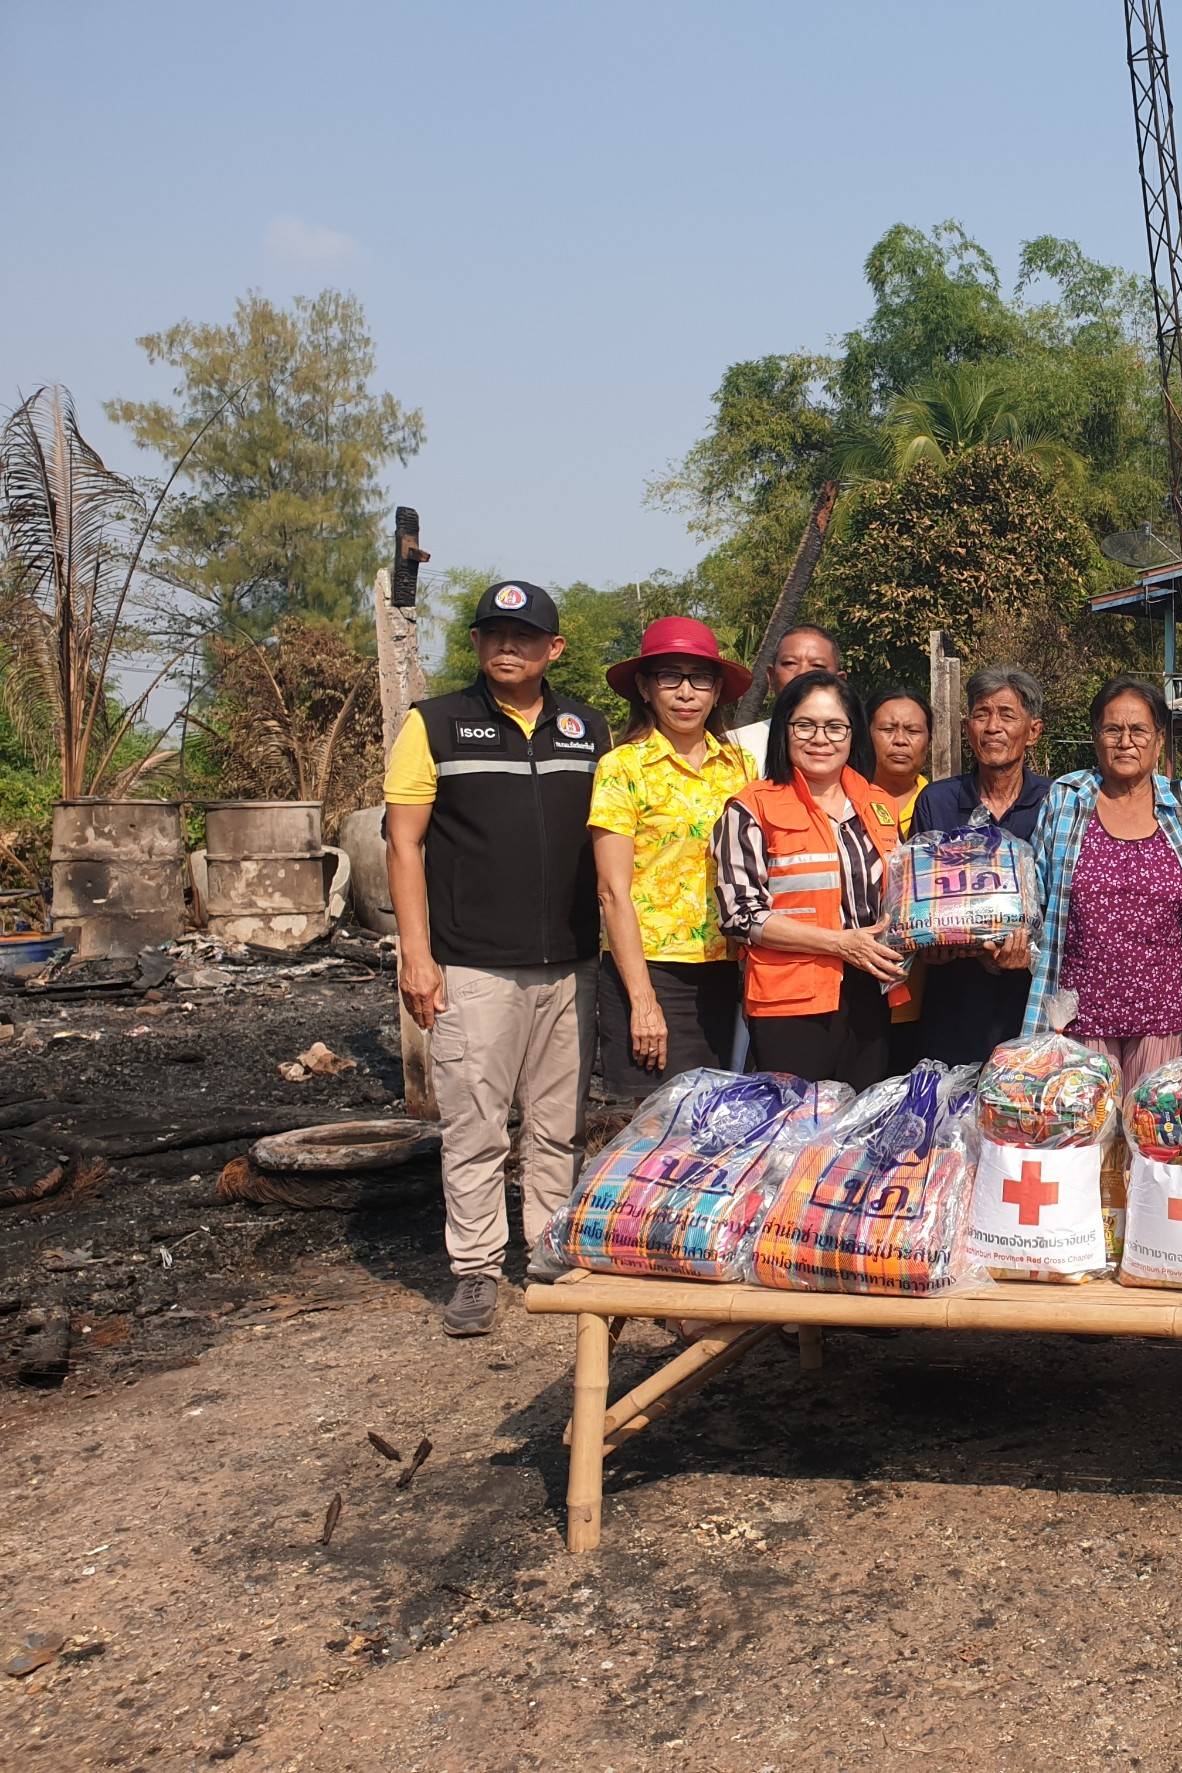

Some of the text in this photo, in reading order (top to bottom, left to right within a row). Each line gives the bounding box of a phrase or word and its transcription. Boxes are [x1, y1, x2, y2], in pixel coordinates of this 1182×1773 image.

[460, 727, 496, 739] ISOC
[934, 869, 1008, 895] ปภ.
[993, 1252, 1024, 1262] Province
[1026, 1256, 1042, 1264] Red
[1043, 1257, 1066, 1265] Cross
